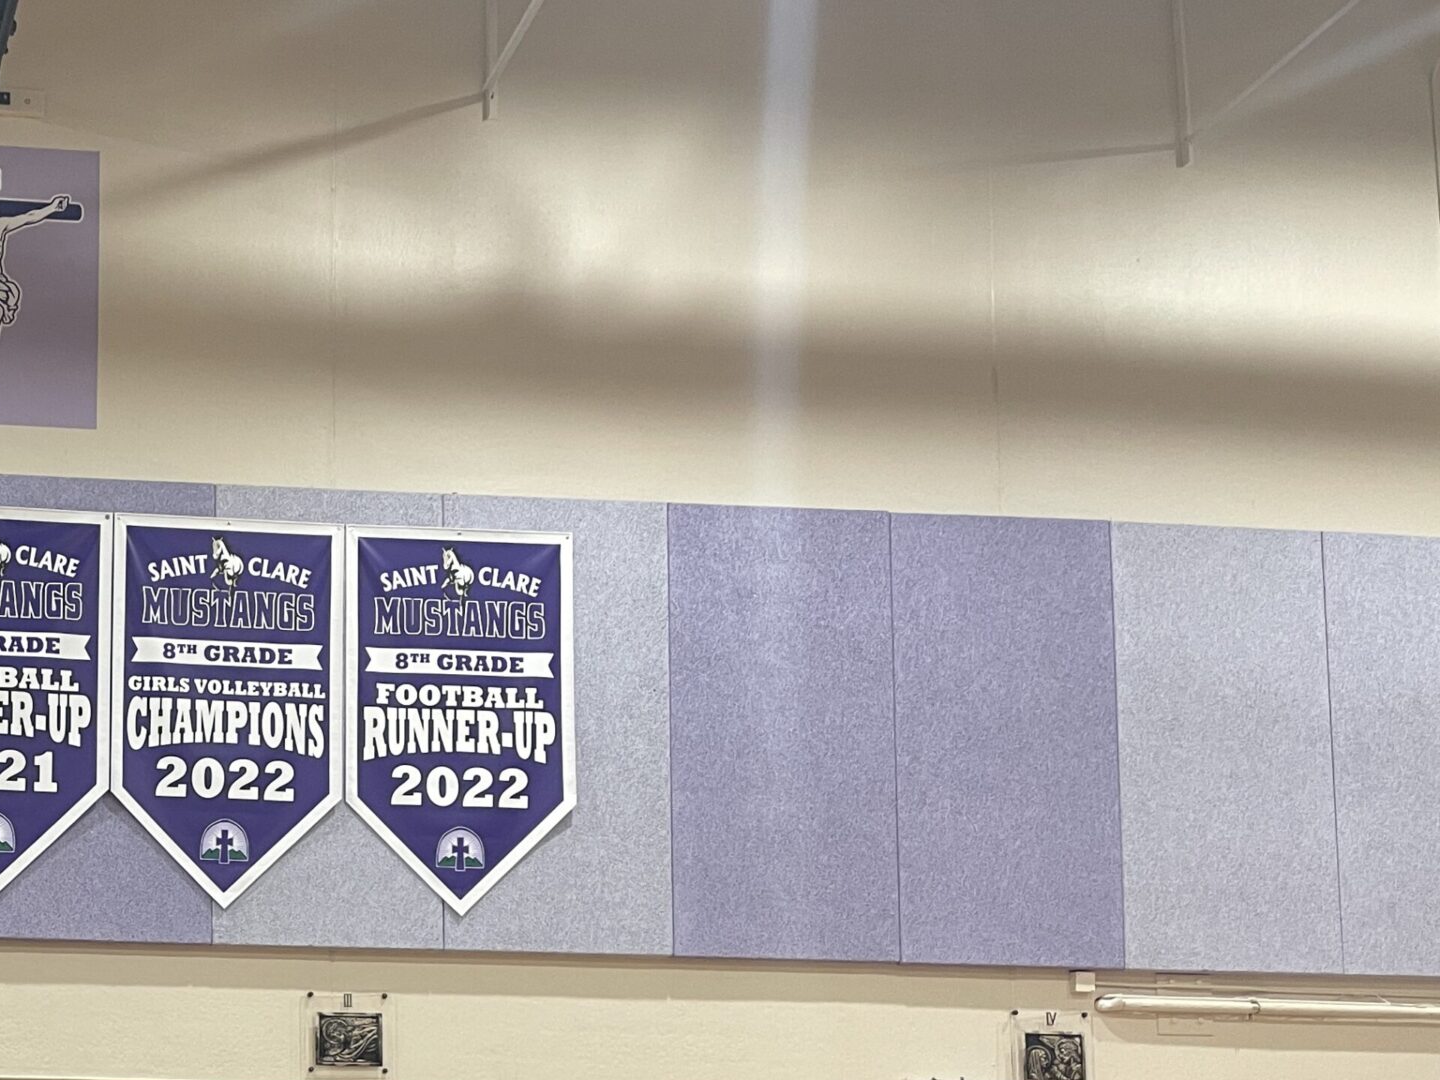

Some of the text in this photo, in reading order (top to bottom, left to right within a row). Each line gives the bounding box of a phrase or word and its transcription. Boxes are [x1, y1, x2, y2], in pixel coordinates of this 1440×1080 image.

[15, 546, 79, 577] CLARE
[148, 555, 312, 590] SAINT CLARE
[380, 565, 541, 598] SAINT CLARE
[142, 586, 315, 631] MUSTANGS
[374, 597, 545, 639] MUSTANGS
[162, 643, 293, 665] 8TH GRADE
[395, 653, 523, 674] 8TH GRADE
[128, 676, 325, 699] GIRLS VOLLEYBALL
[376, 683, 543, 710] FOOTBALL
[126, 696, 324, 759] CHAMPIONS
[363, 707, 556, 764] RUNNER-UP
[155, 756, 295, 802] 2022
[390, 765, 529, 809] 2022
